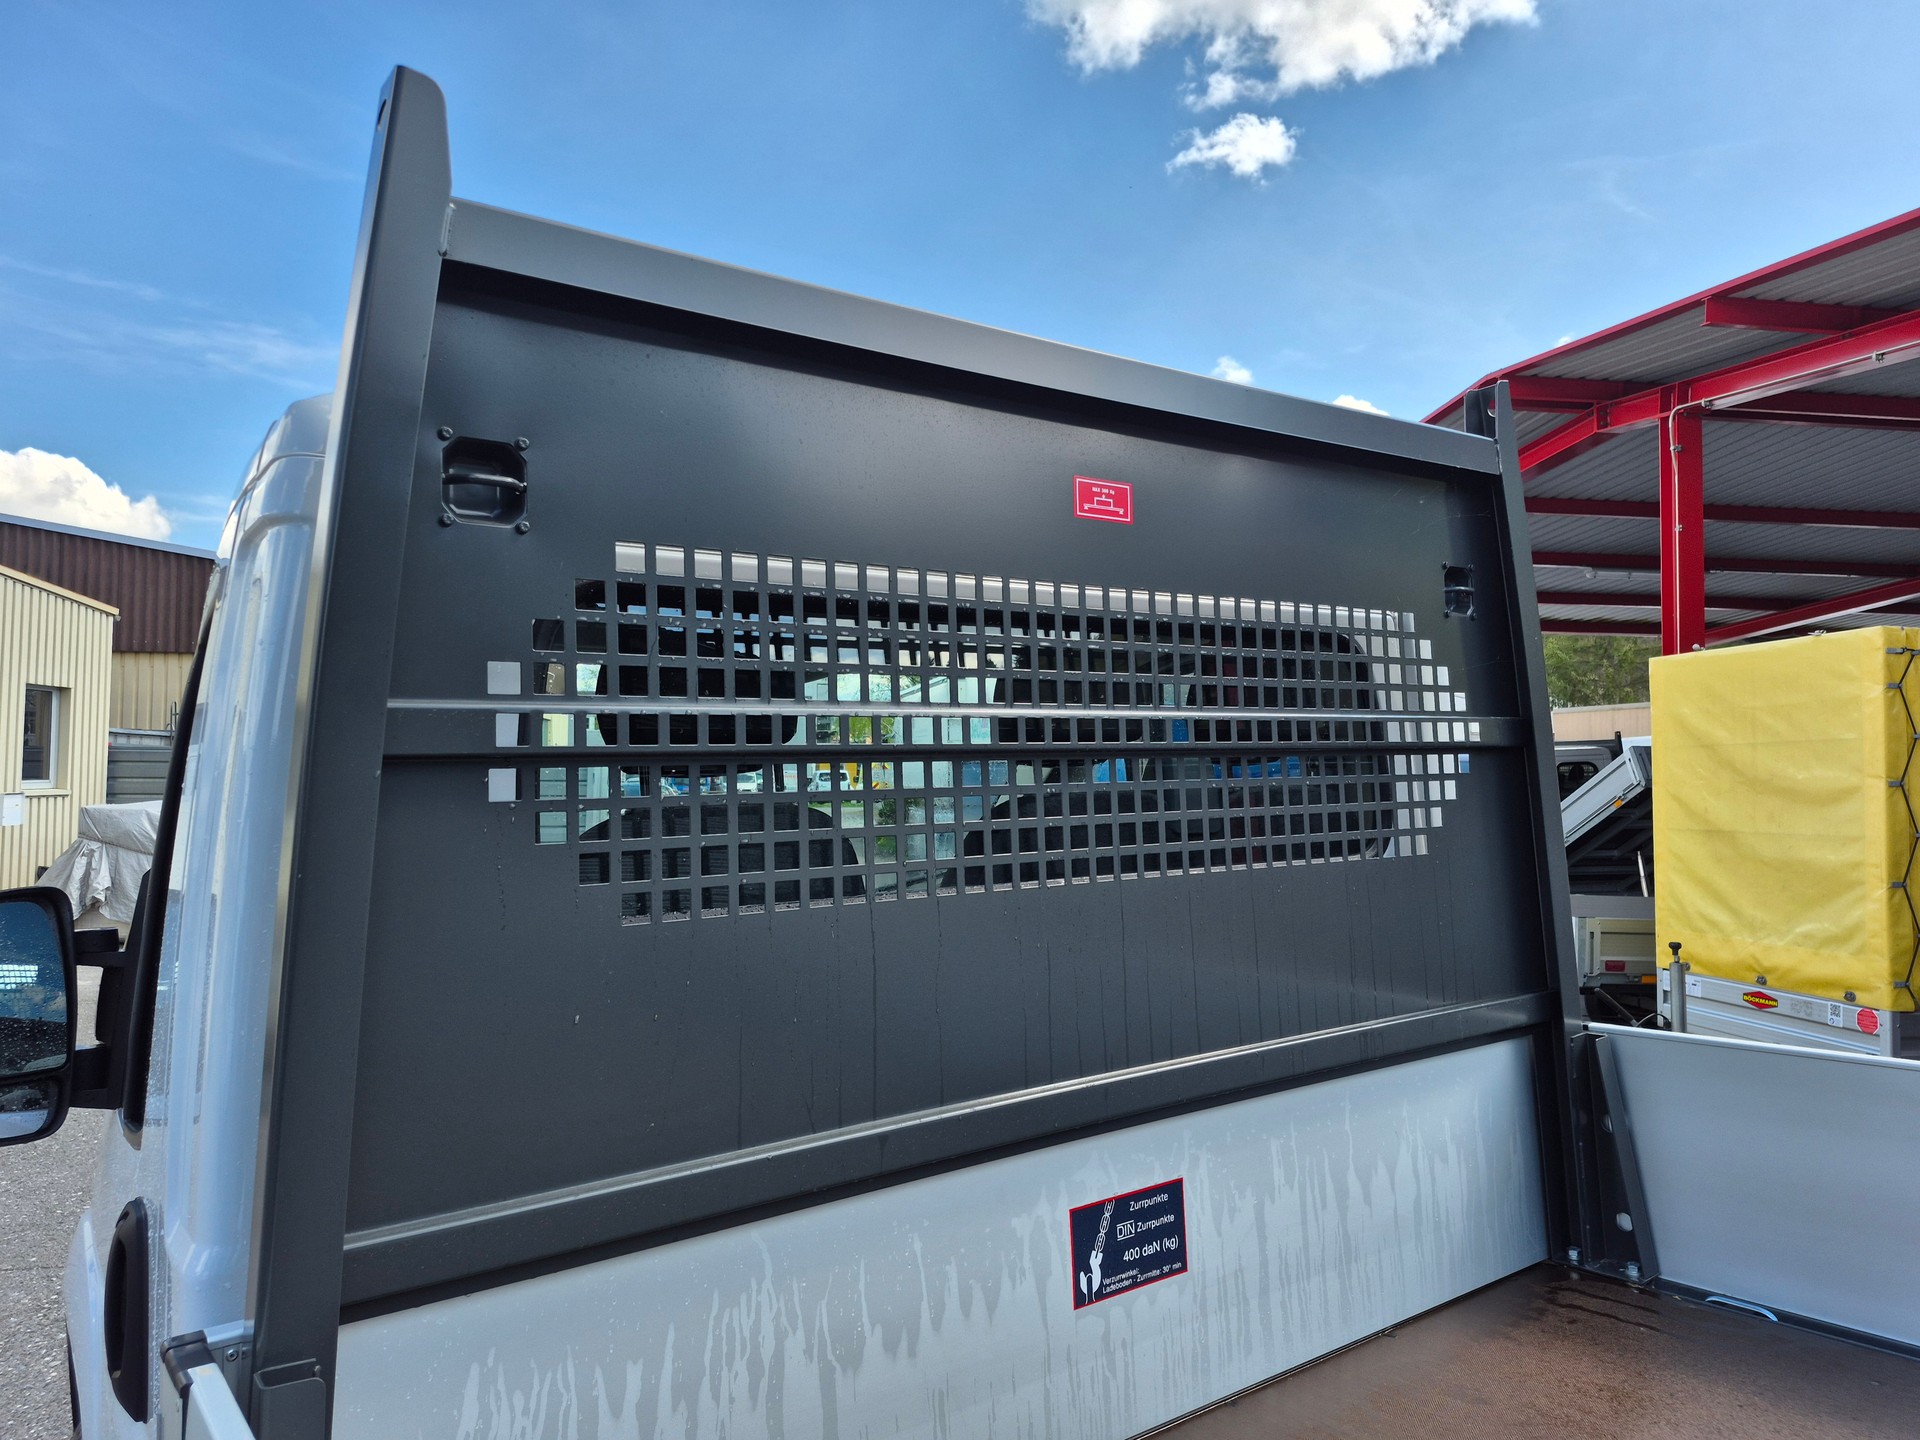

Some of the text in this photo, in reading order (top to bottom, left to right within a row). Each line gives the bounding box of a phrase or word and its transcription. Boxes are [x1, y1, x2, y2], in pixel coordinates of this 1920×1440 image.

[1743, 994, 1778, 1007] BÖCKMANN
[1129, 1192, 1169, 1211] Zurrpunkte
[1116, 1213, 1175, 1240] DIN Zurrpunkte
[1123, 1235, 1179, 1262] 400 daN (kg)
[1102, 1279, 1132, 1294] Ladeboden
[1172, 1262, 1182, 1270] min
